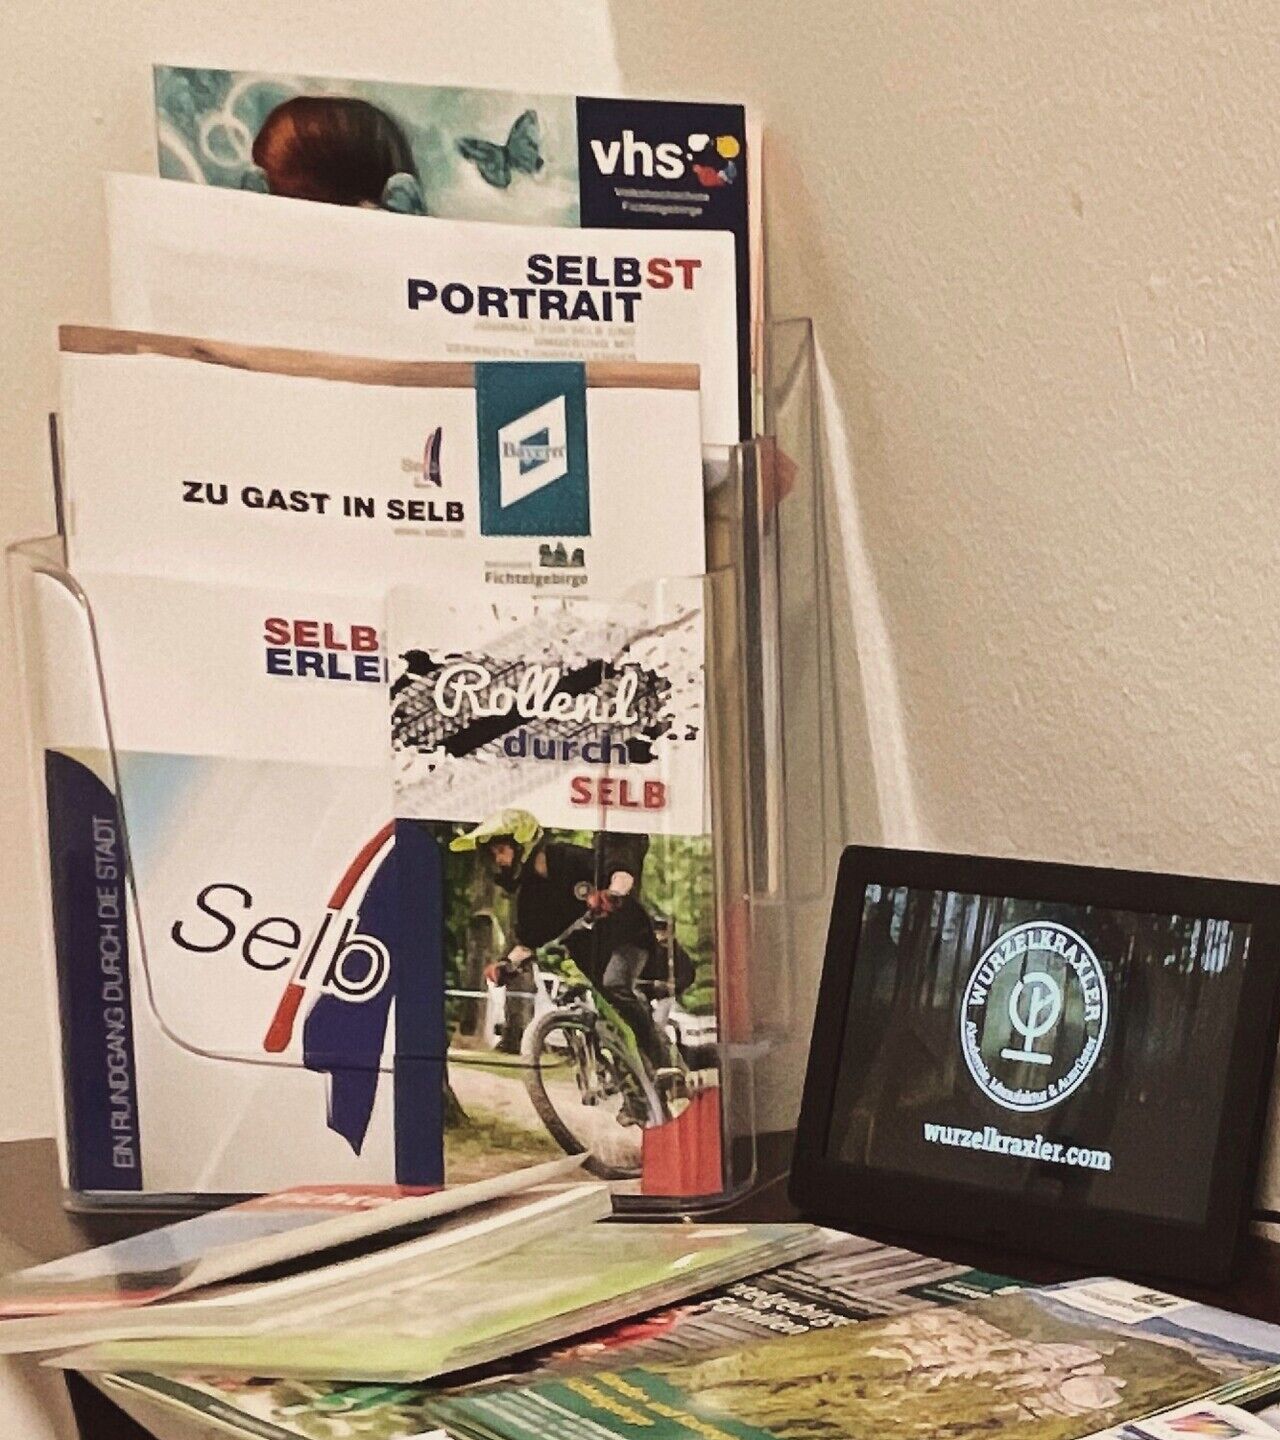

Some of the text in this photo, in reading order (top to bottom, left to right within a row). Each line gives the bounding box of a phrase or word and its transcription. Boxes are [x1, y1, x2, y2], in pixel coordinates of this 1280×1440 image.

[590, 129, 686, 180] vhs
[407, 278, 642, 323] PORTRAIT
[182, 481, 465, 522] ZU GAST IN SELB
[484, 571, 589, 588] Fichtelgebirge
[264, 617, 379, 651] SELB
[265, 647, 389, 683] ERLE
[434, 662, 639, 726] Rollend
[503, 728, 628, 766] durch
[570, 776, 667, 809] SELB
[171, 882, 391, 1004] Selb
[91, 814, 136, 1169] EIN RUNDGANG DURCH DIE STADT
[967, 929, 1102, 1021] WURZELKRAXLER
[923, 1120, 1112, 1172] wurzelkraxler.com
